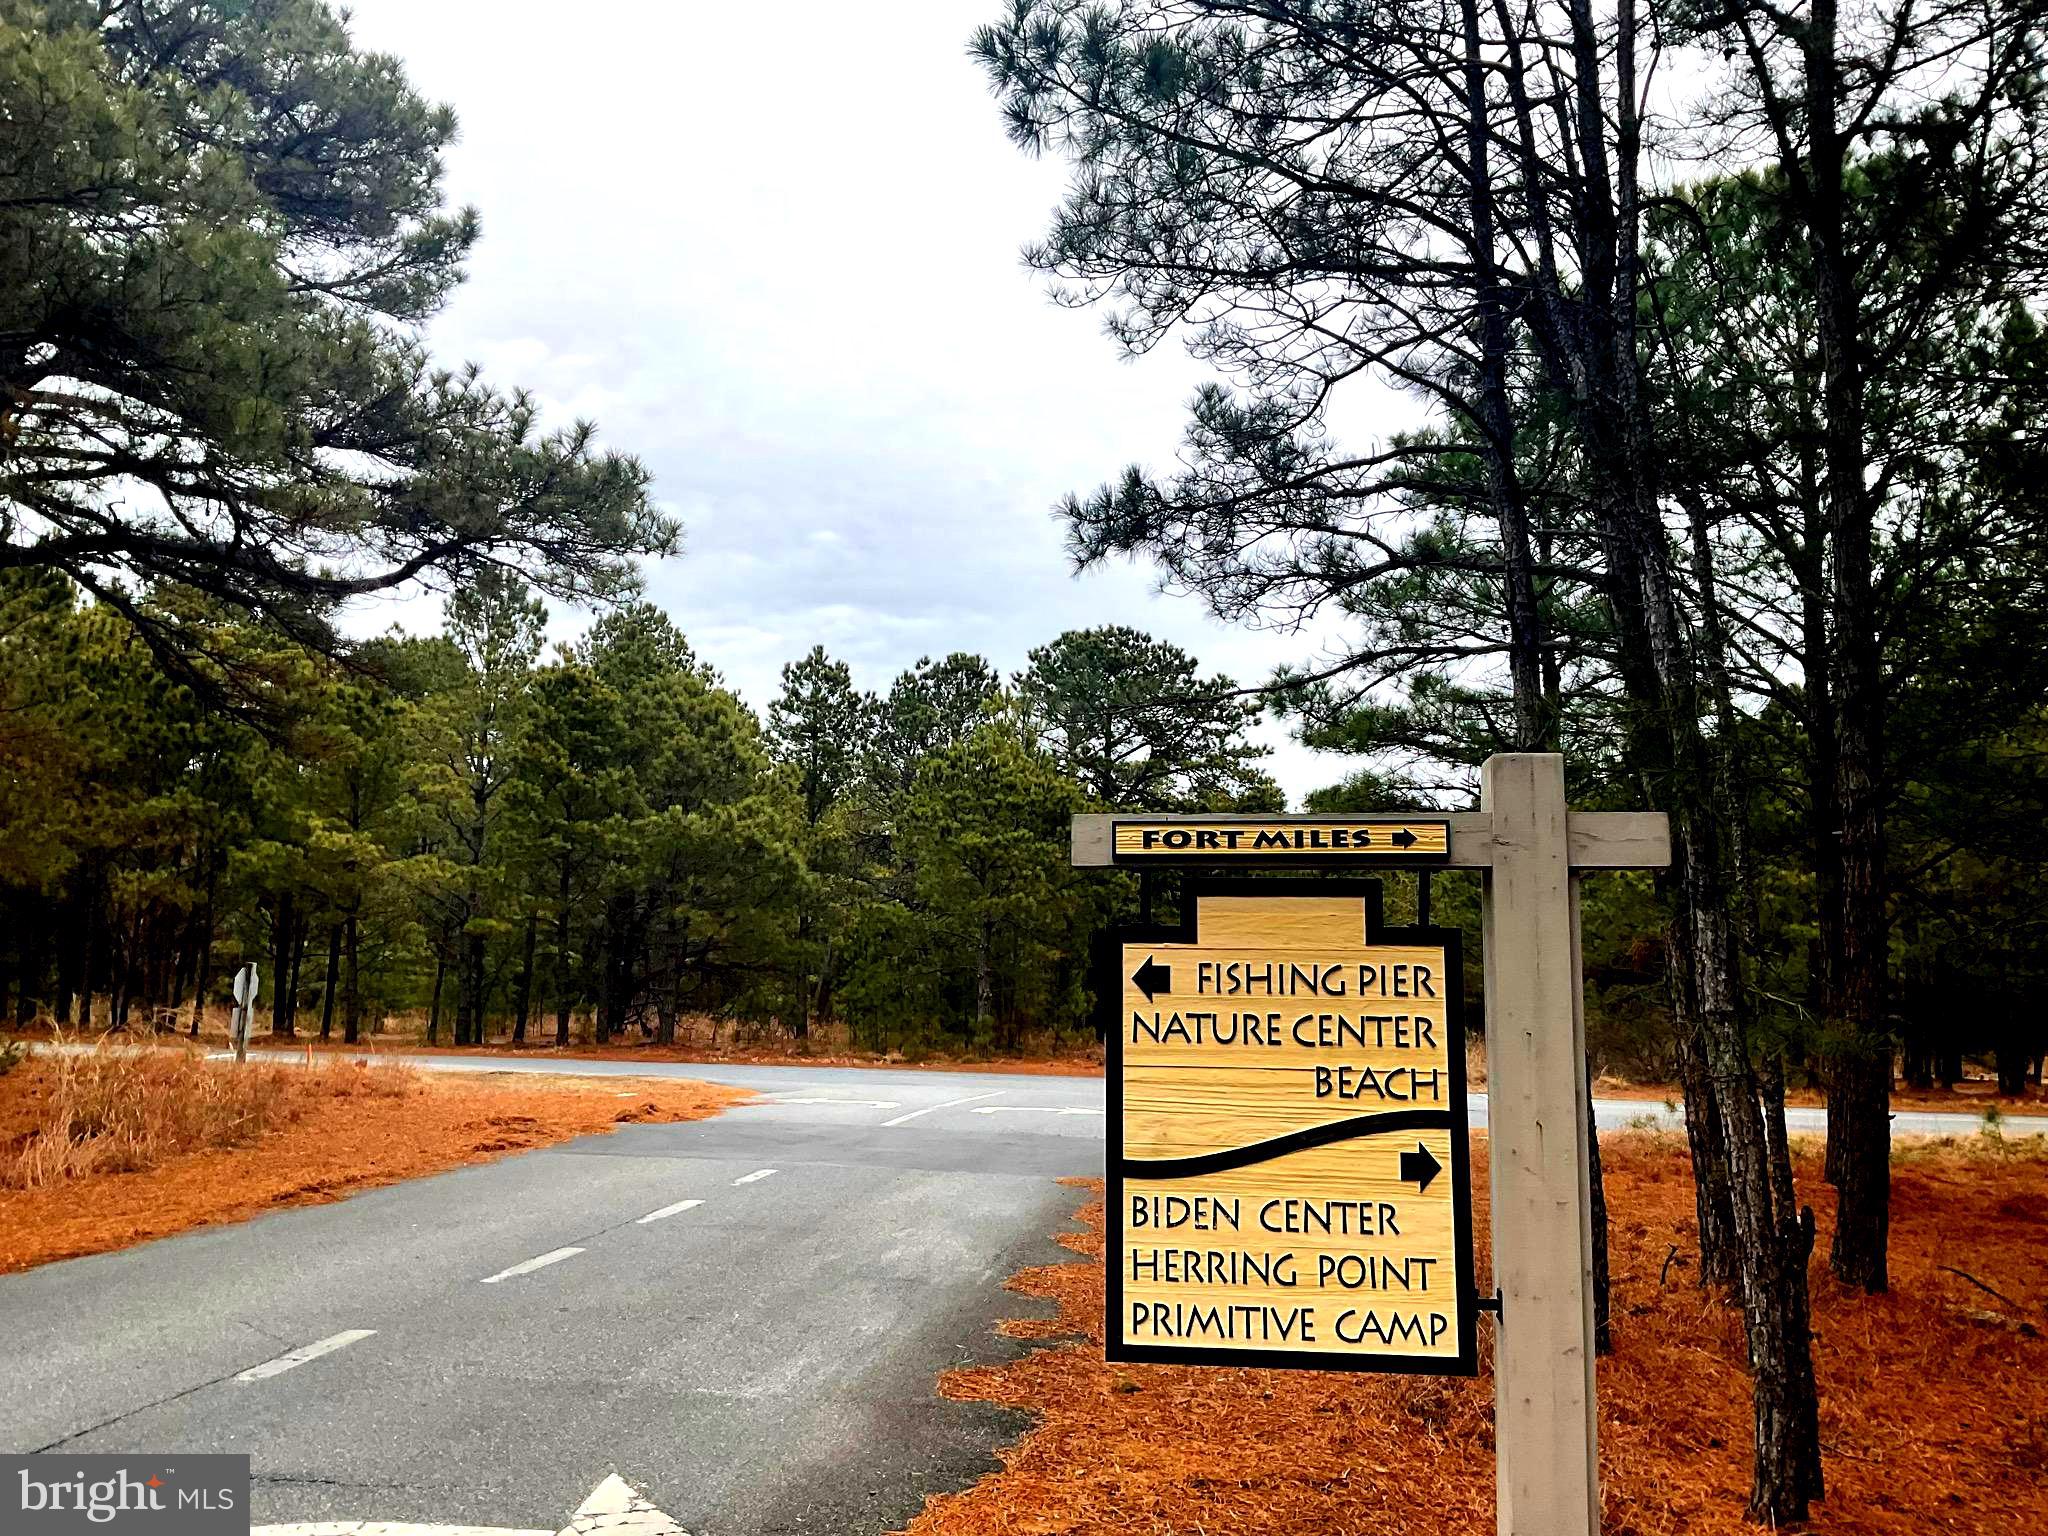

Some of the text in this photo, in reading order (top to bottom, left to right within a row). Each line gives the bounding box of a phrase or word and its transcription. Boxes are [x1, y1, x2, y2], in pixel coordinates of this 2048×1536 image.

[1142, 829, 1371, 850] FORT MILES
[1198, 962, 1436, 998] FISHING PIER
[1132, 1011, 1437, 1049] NATURE CENTER
[1315, 1065, 1439, 1101] BEACH
[1132, 1195, 1400, 1236] BIDEN CENTER
[1132, 1248, 1437, 1291] HERRING POINT
[1132, 1302, 1449, 1348] PRIMITIVE CAMP
